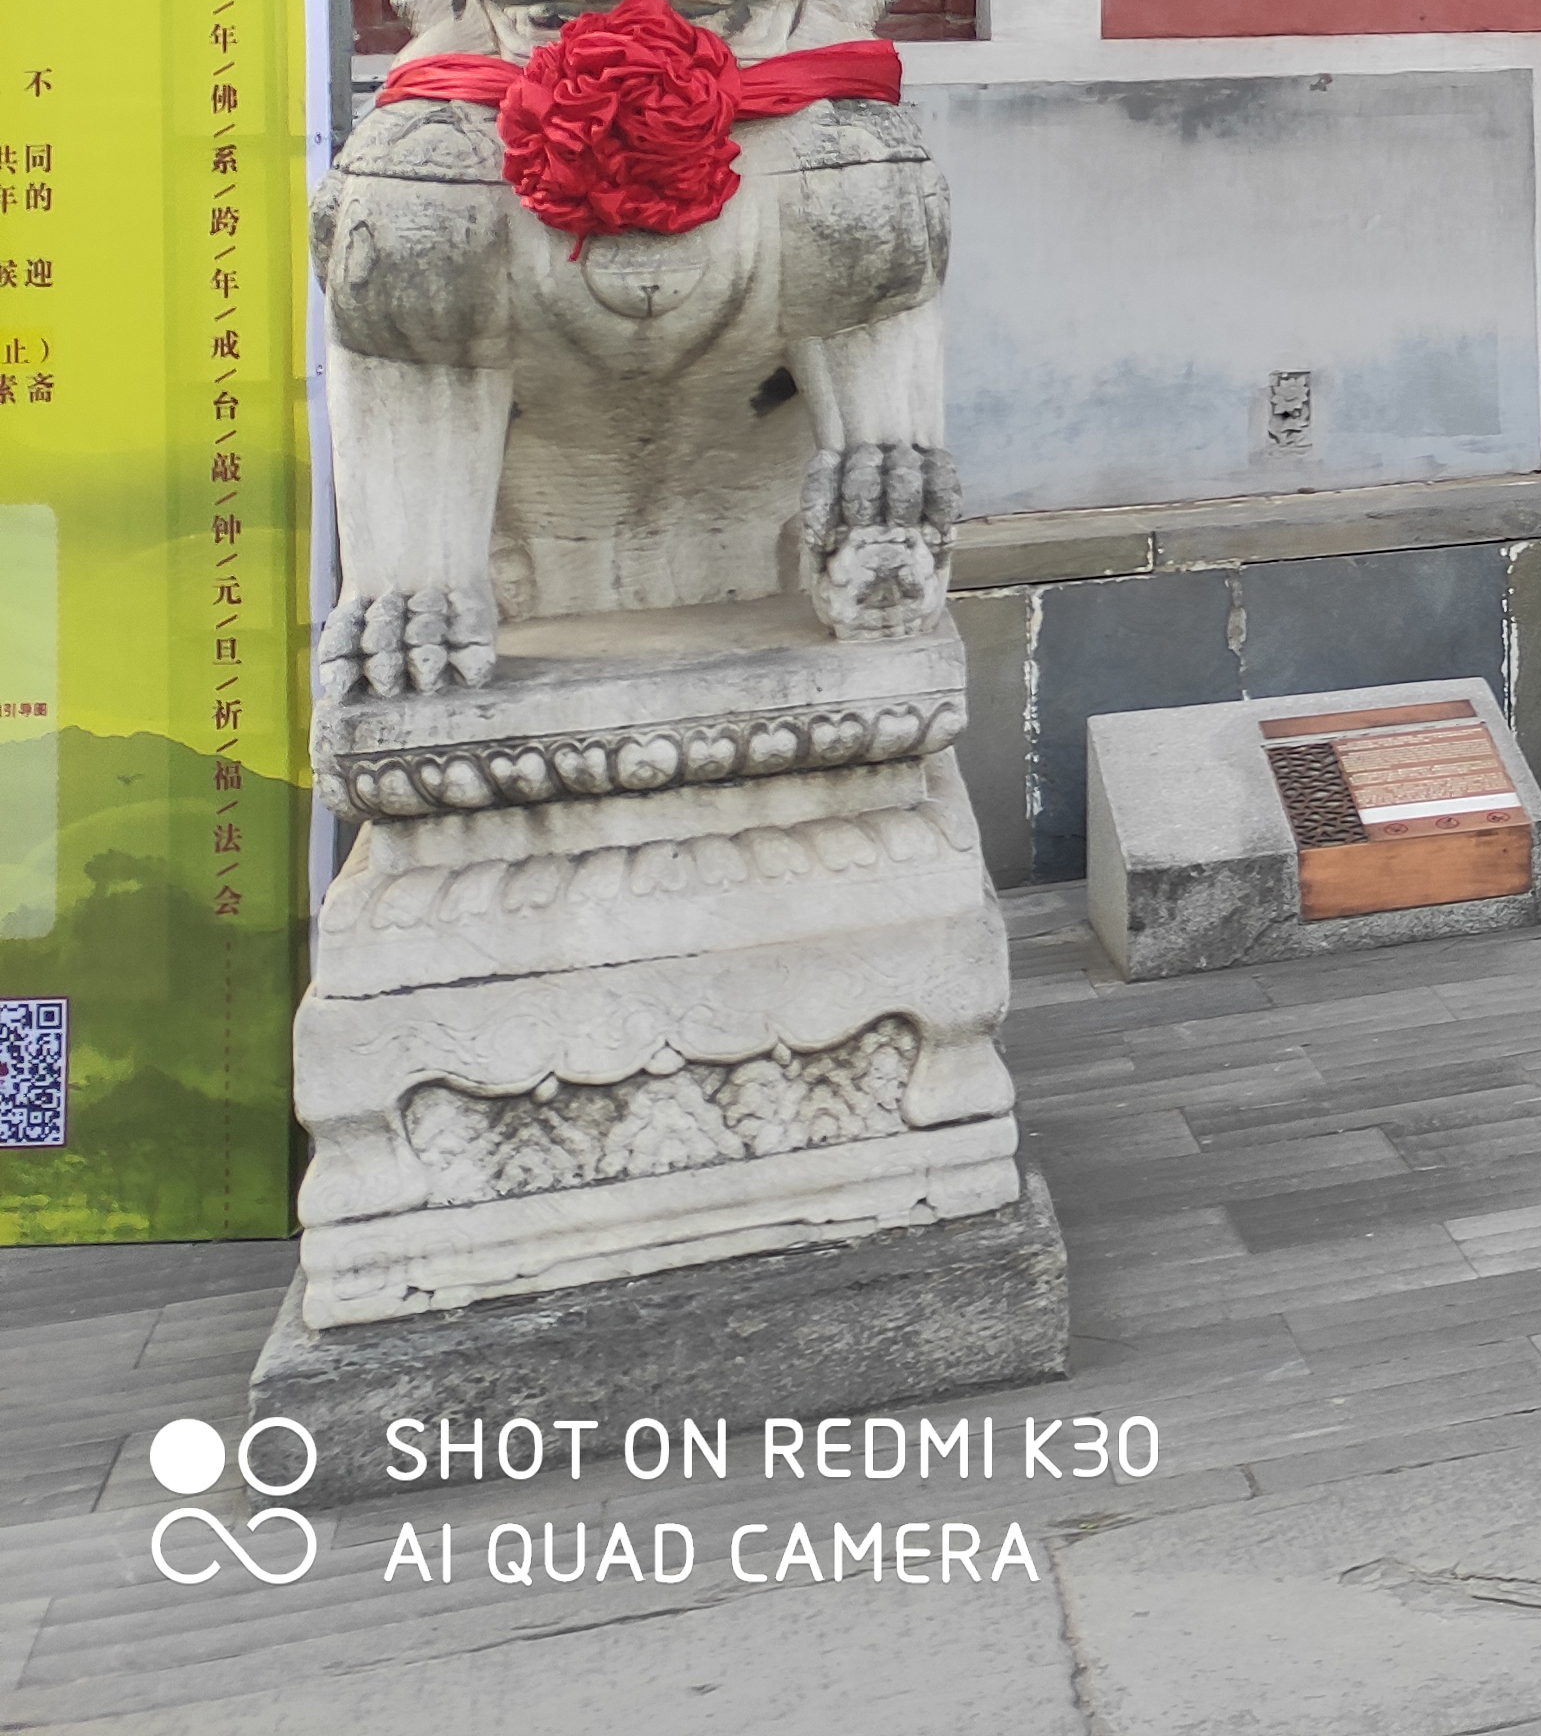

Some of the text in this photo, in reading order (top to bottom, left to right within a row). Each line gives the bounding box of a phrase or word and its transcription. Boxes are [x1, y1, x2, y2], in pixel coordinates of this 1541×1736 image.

[24, 68, 53, 98] 不
[0, 702, 47, 718] 引导图
